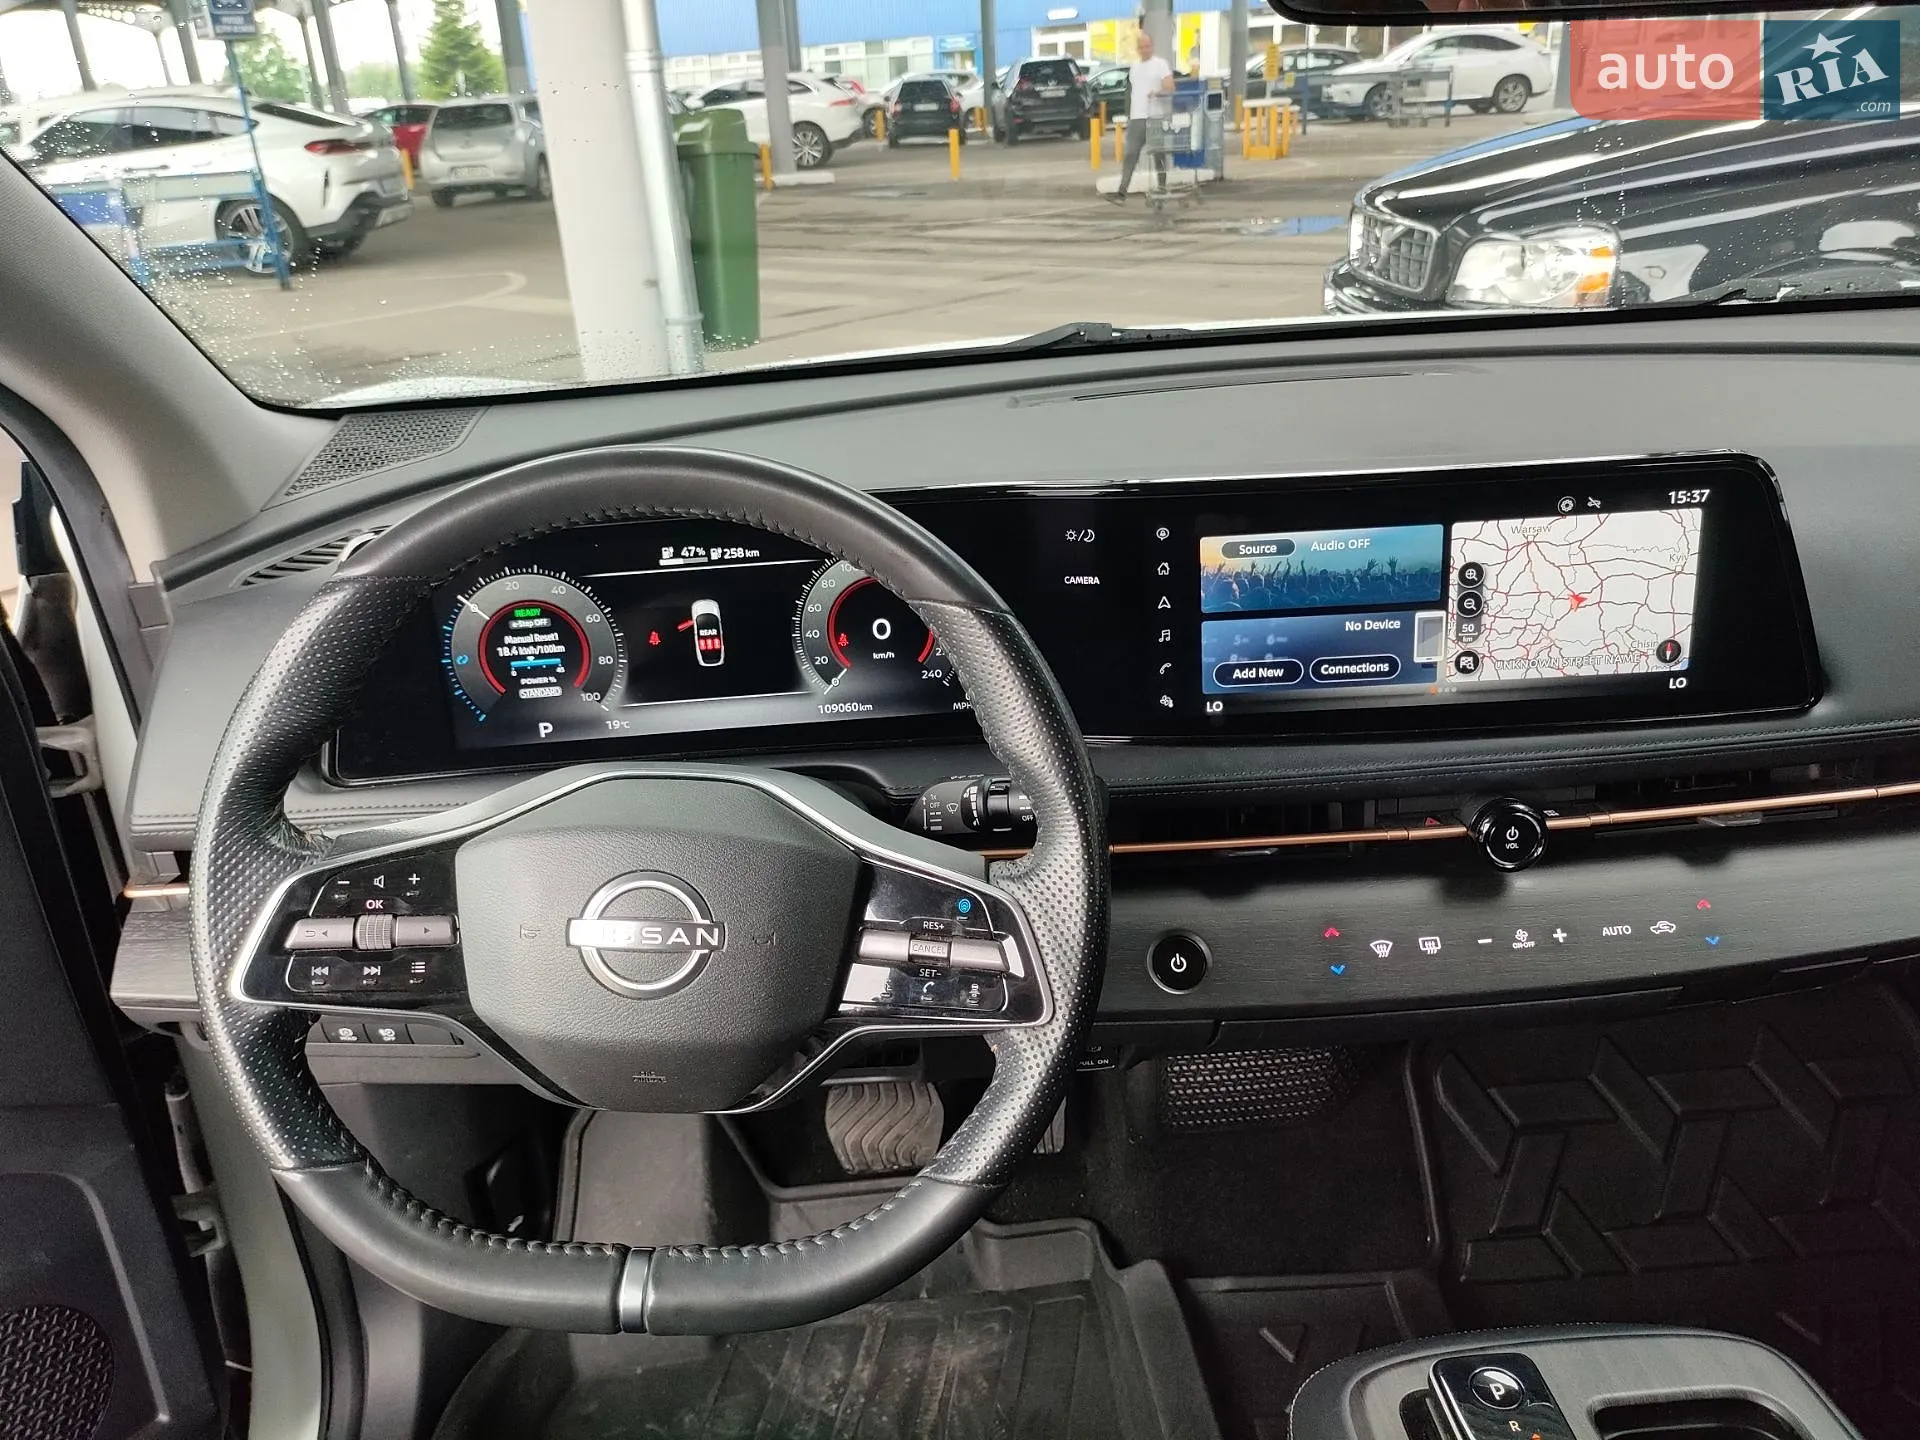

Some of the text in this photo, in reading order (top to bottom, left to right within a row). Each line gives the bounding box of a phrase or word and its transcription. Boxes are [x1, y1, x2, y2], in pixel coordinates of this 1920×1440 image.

[1668, 489, 1711, 504] 15:37
[1510, 524, 1552, 535] Warsaw
[1239, 543, 1277, 555] Source
[1310, 537, 1370, 552] Audio OFF
[821, 579, 836, 589] 80
[1064, 575, 1100, 585] CAMERA
[505, 581, 520, 591] 20
[551, 586, 567, 595] 40
[807, 603, 822, 613] 60
[586, 614, 600, 623] 60
[872, 618, 891, 640] 0
[1345, 618, 1401, 631] No Device
[1462, 623, 1475, 632] 50
[503, 634, 534, 644] Manual
[806, 629, 820, 639] 40
[497, 645, 518, 656] 18.4
[873, 650, 895, 660] km/h
[598, 655, 613, 665] 80
[814, 655, 829, 665] 20
[1495, 658, 1560, 671] UNKNOWN
[1604, 653, 1642, 665] NAME
[1233, 665, 1284, 679] Add New
[1320, 661, 1389, 675] Connections
[921, 669, 942, 679] 240
[520, 677, 548, 685] POWER
[1668, 677, 1687, 689] LO
[520, 687, 562, 698] STANDARD
[581, 692, 600, 702] 100
[1206, 701, 1223, 712] LO
[538, 722, 553, 738] P
[366, 900, 384, 909] OK
[923, 921, 945, 930] RES+
[1602, 925, 1631, 936] AUTO
[912, 943, 945, 954] CANCEL
[1489, 1384, 1505, 1400] P
[1509, 1420, 1521, 1432] R
